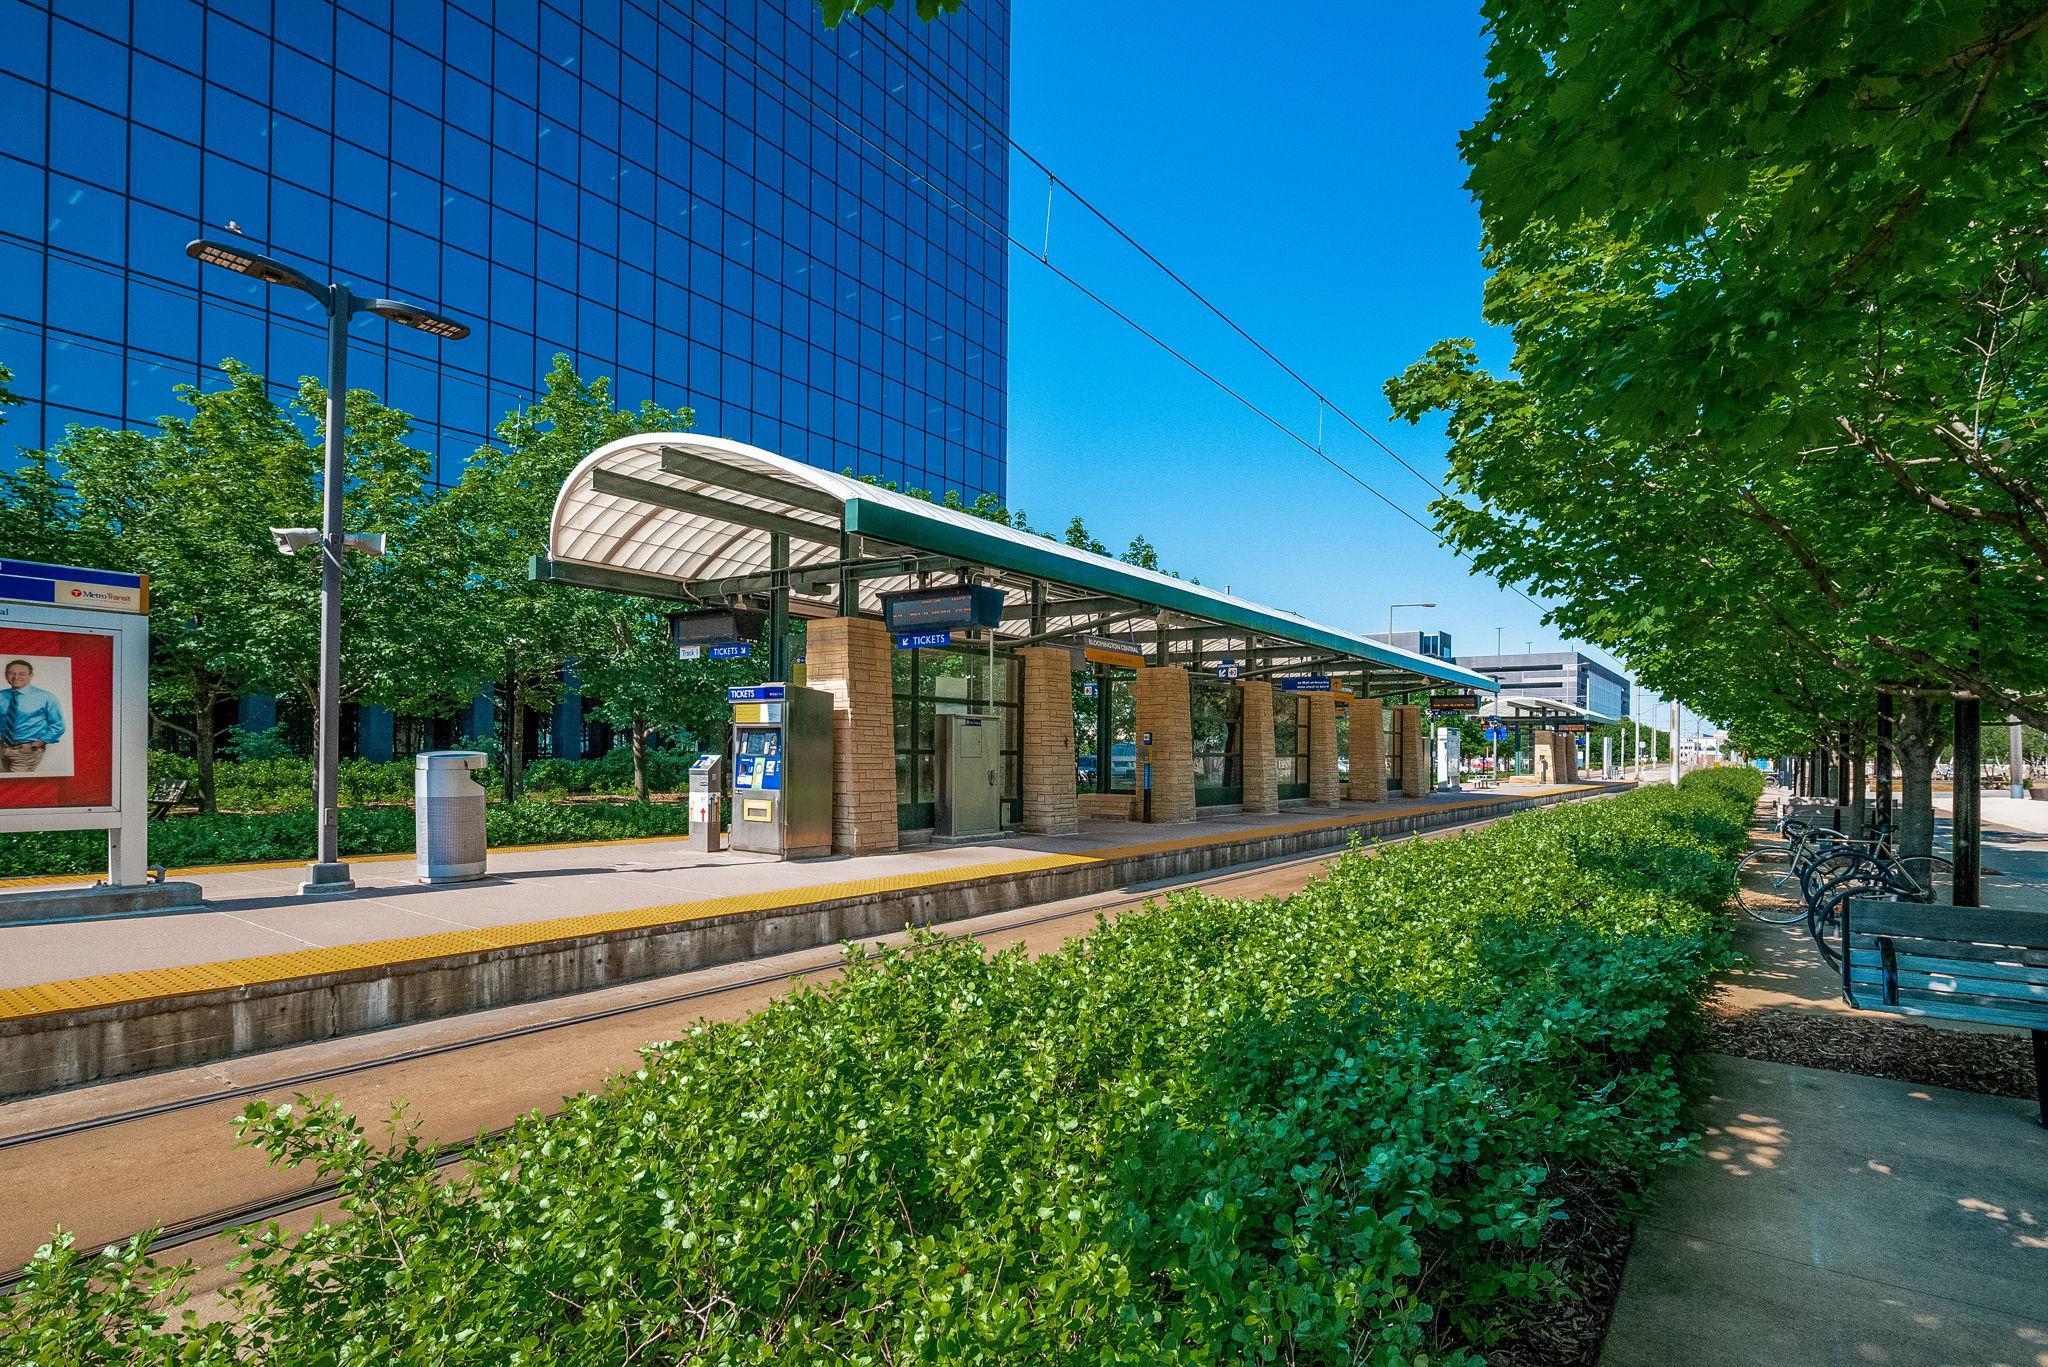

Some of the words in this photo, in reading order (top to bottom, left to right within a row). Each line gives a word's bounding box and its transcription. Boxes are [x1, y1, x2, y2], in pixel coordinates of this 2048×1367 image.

[913, 634, 945, 645] TICKETS
[714, 646, 738, 656] TICKETS
[1088, 638, 1120, 650] BLOOMINGTON
[1121, 644, 1139, 654] CENTRAL
[731, 690, 755, 698] TICKETS
